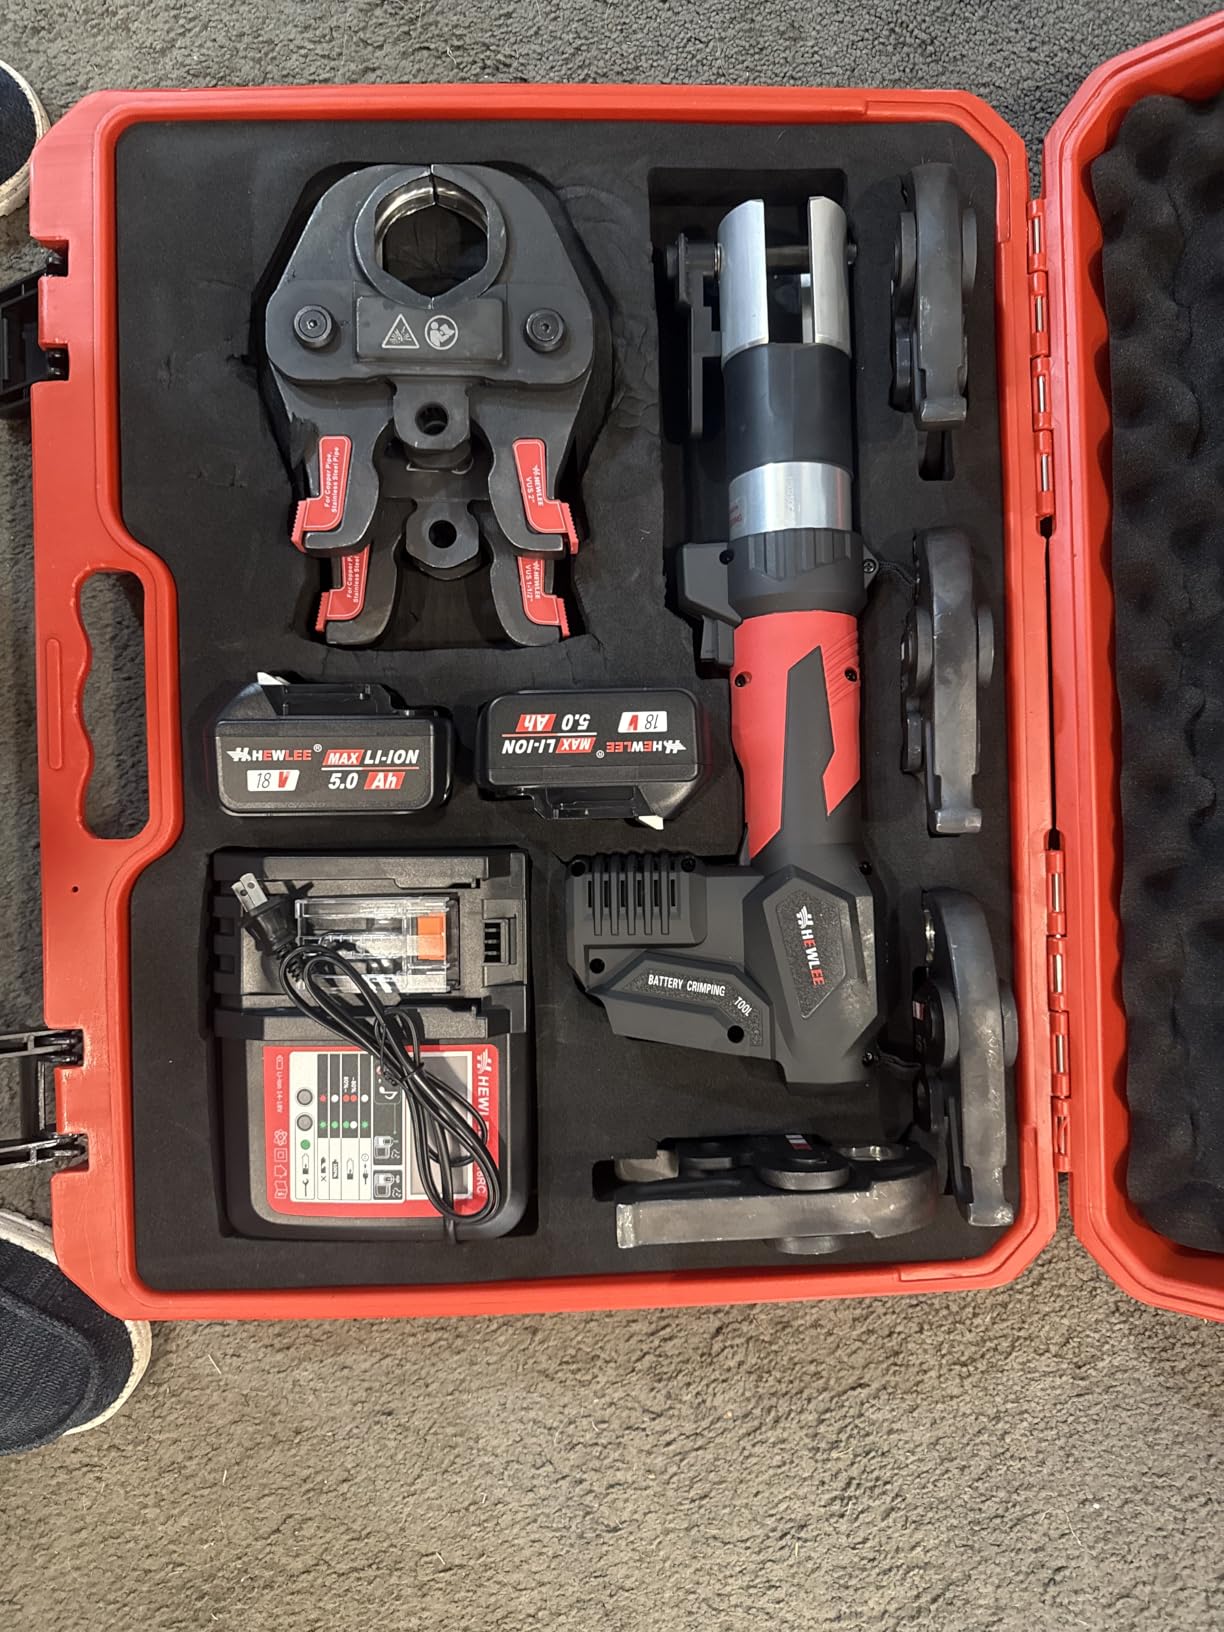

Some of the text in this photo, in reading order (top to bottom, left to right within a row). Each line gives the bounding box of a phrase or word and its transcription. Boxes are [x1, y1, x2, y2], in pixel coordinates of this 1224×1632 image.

[534, 476, 544, 506] HEWLEE
[524, 714, 590, 730] 5.0 Ah
[628, 714, 659, 730] 18 V
[502, 738, 590, 754] MAX LI-ION
[606, 742, 662, 752] HEWLEE
[252, 750, 312, 762] HEWLEE
[328, 750, 420, 765] MAX LI-ION
[256, 771, 291, 788] 18 V
[328, 772, 398, 790] 5.0 Ah
[800, 929, 825, 986] HEWLEE
[648, 974, 726, 996] BATTERY CRIMPING
[734, 996, 753, 1016] TOOL
